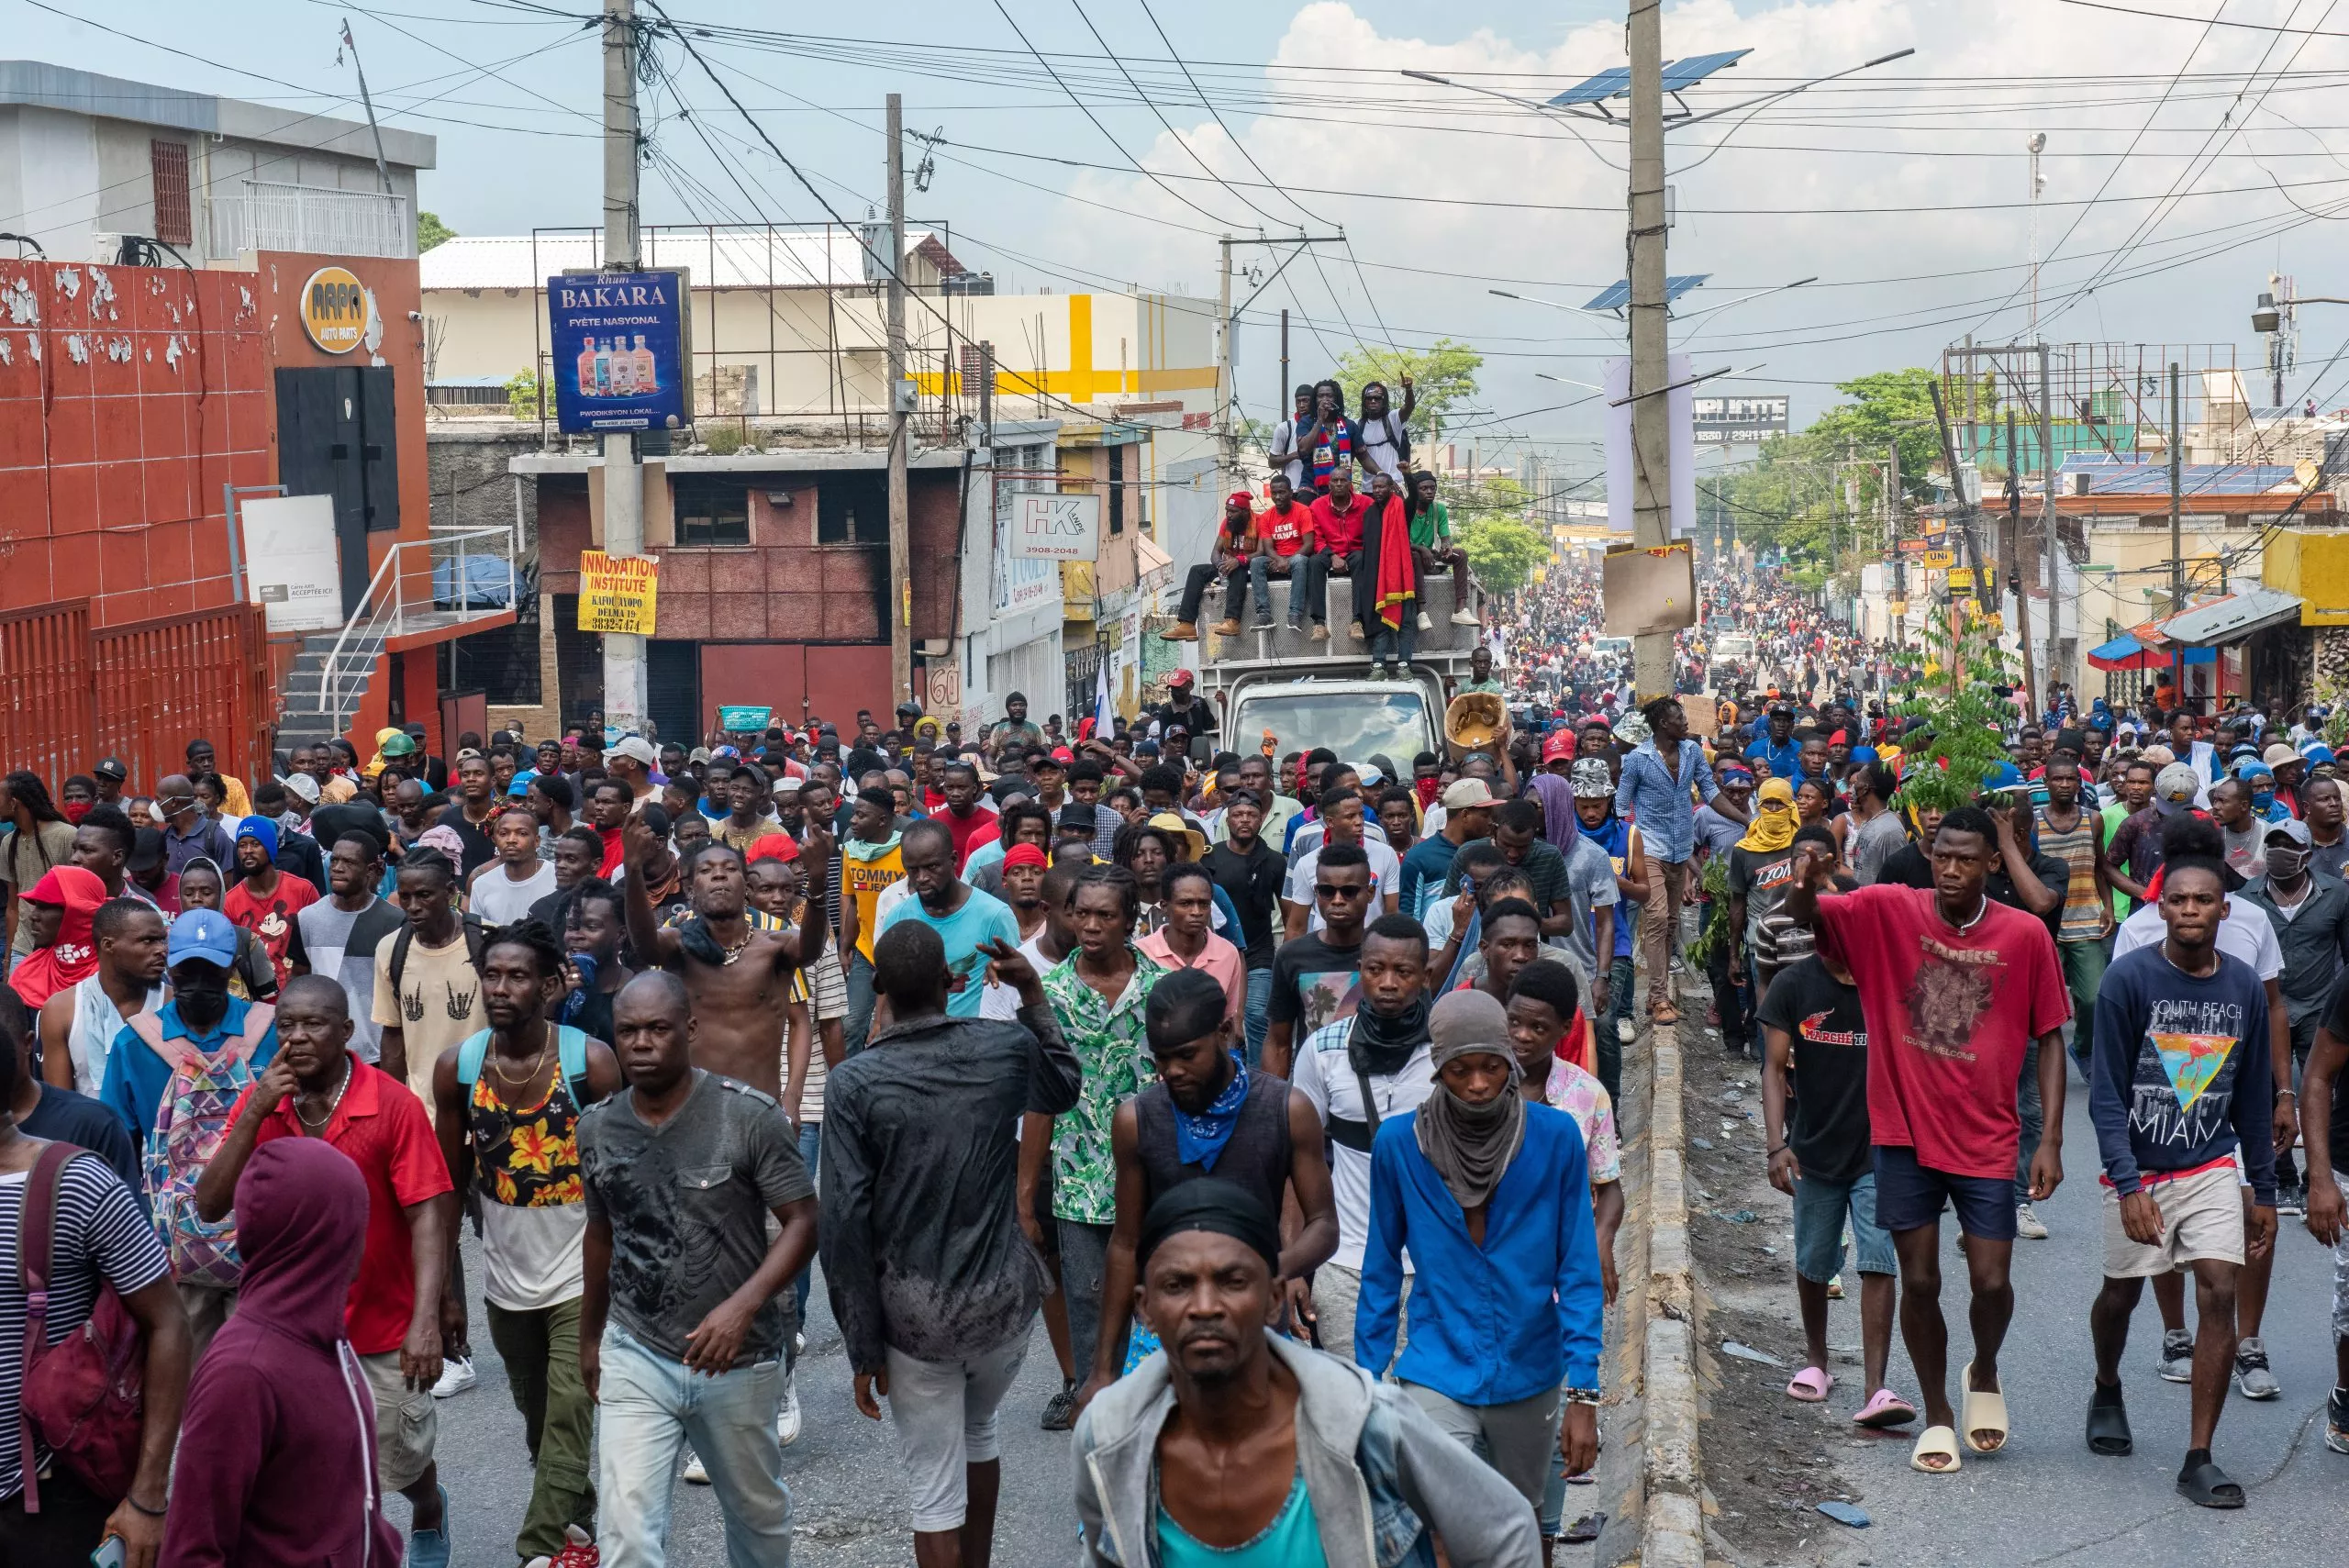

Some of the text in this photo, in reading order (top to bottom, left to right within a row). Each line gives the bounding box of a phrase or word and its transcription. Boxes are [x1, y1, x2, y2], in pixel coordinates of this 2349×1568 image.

[597, 274, 629, 284] Rhum
[561, 286, 667, 308] BAKARA
[604, 316, 660, 326] NASYONAL
[321, 327, 357, 340] AUTO PARTS
[1275, 522, 1294, 532] LEVE
[1026, 547, 1078, 555] 3908-2048
[581, 553, 659, 577] INNOVATION
[590, 575, 646, 593] INSTITUTE
[592, 595, 616, 606] KAFOU
[628, 609, 636, 617] 19
[592, 617, 640, 632] 3832-7474
[930, 668, 959, 705] 60
[851, 868, 904, 884] TOMMY
[2151, 999, 2243, 1019] SOUTH BEACH
[1804, 1029, 1853, 1045] MARCHÉ
[1932, 1044, 1977, 1062] WELCOME
